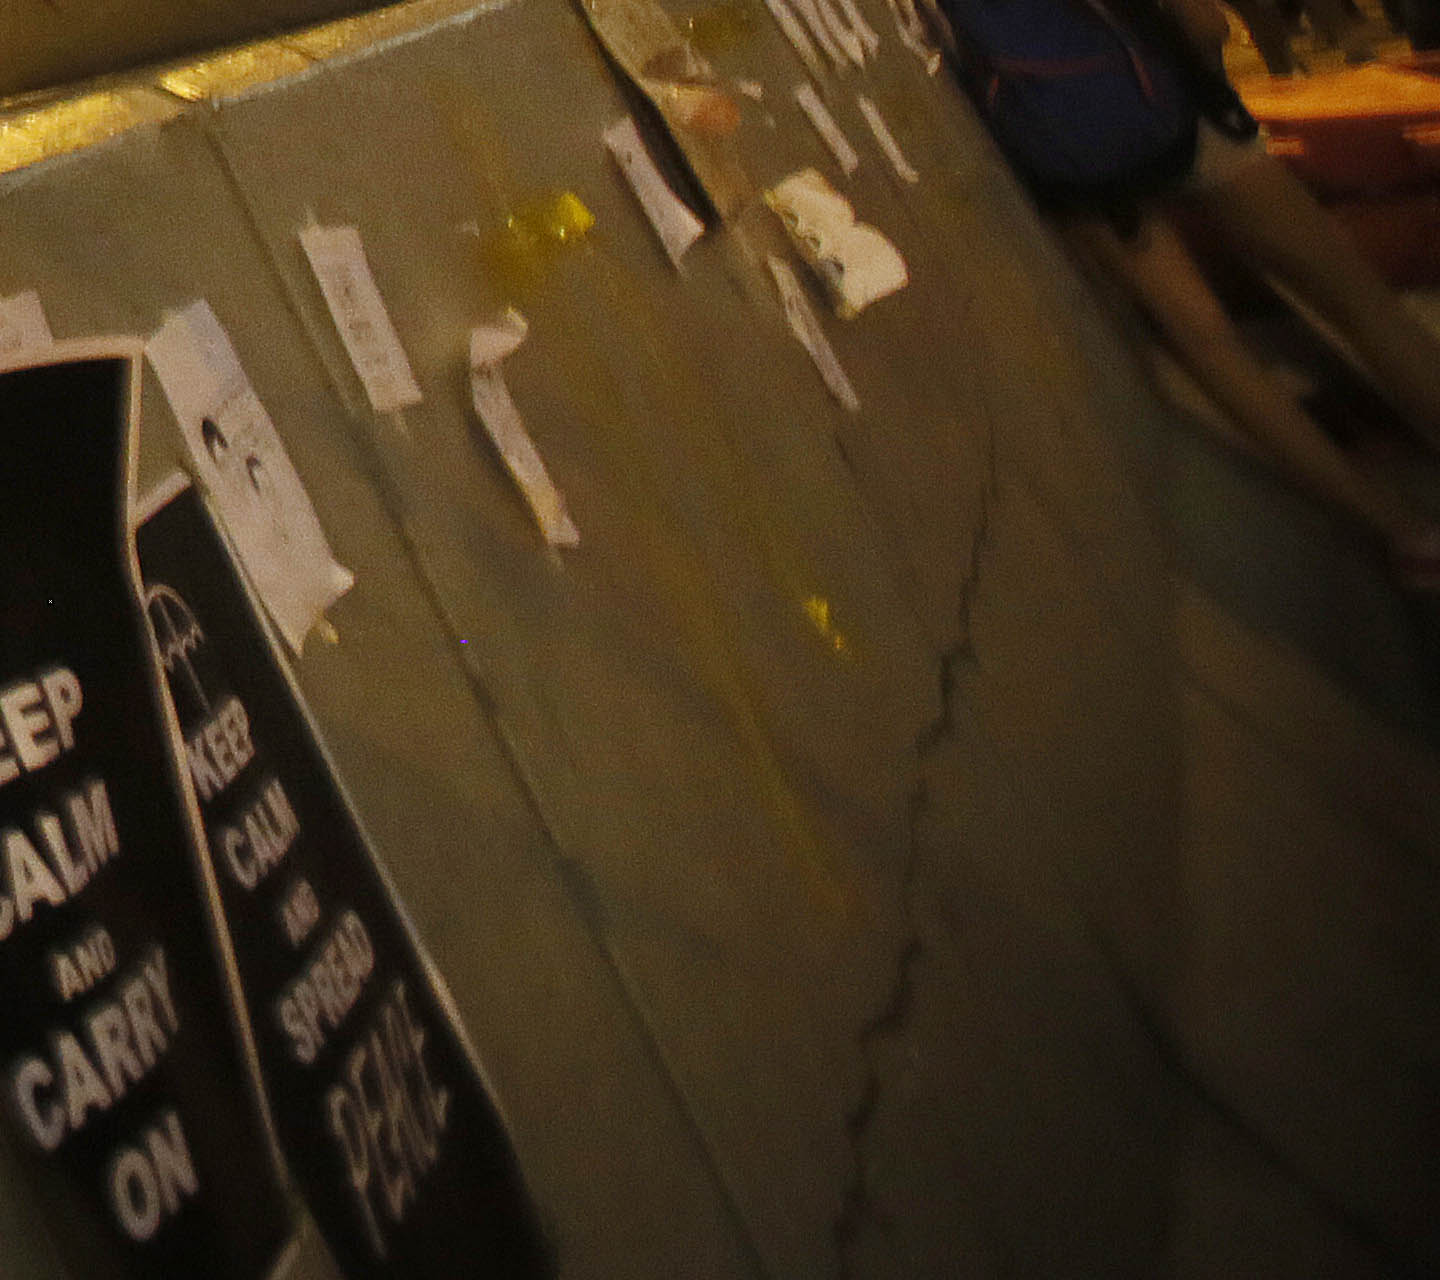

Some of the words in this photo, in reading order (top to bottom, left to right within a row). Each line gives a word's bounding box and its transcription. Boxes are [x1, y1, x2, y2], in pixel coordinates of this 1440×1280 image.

[183, 693, 256, 802] KEEP
[223, 777, 301, 891] CALM
[50, 927, 117, 1001] AND
[13, 945, 180, 1151] CARRY
[110, 1111, 200, 1241] ON
